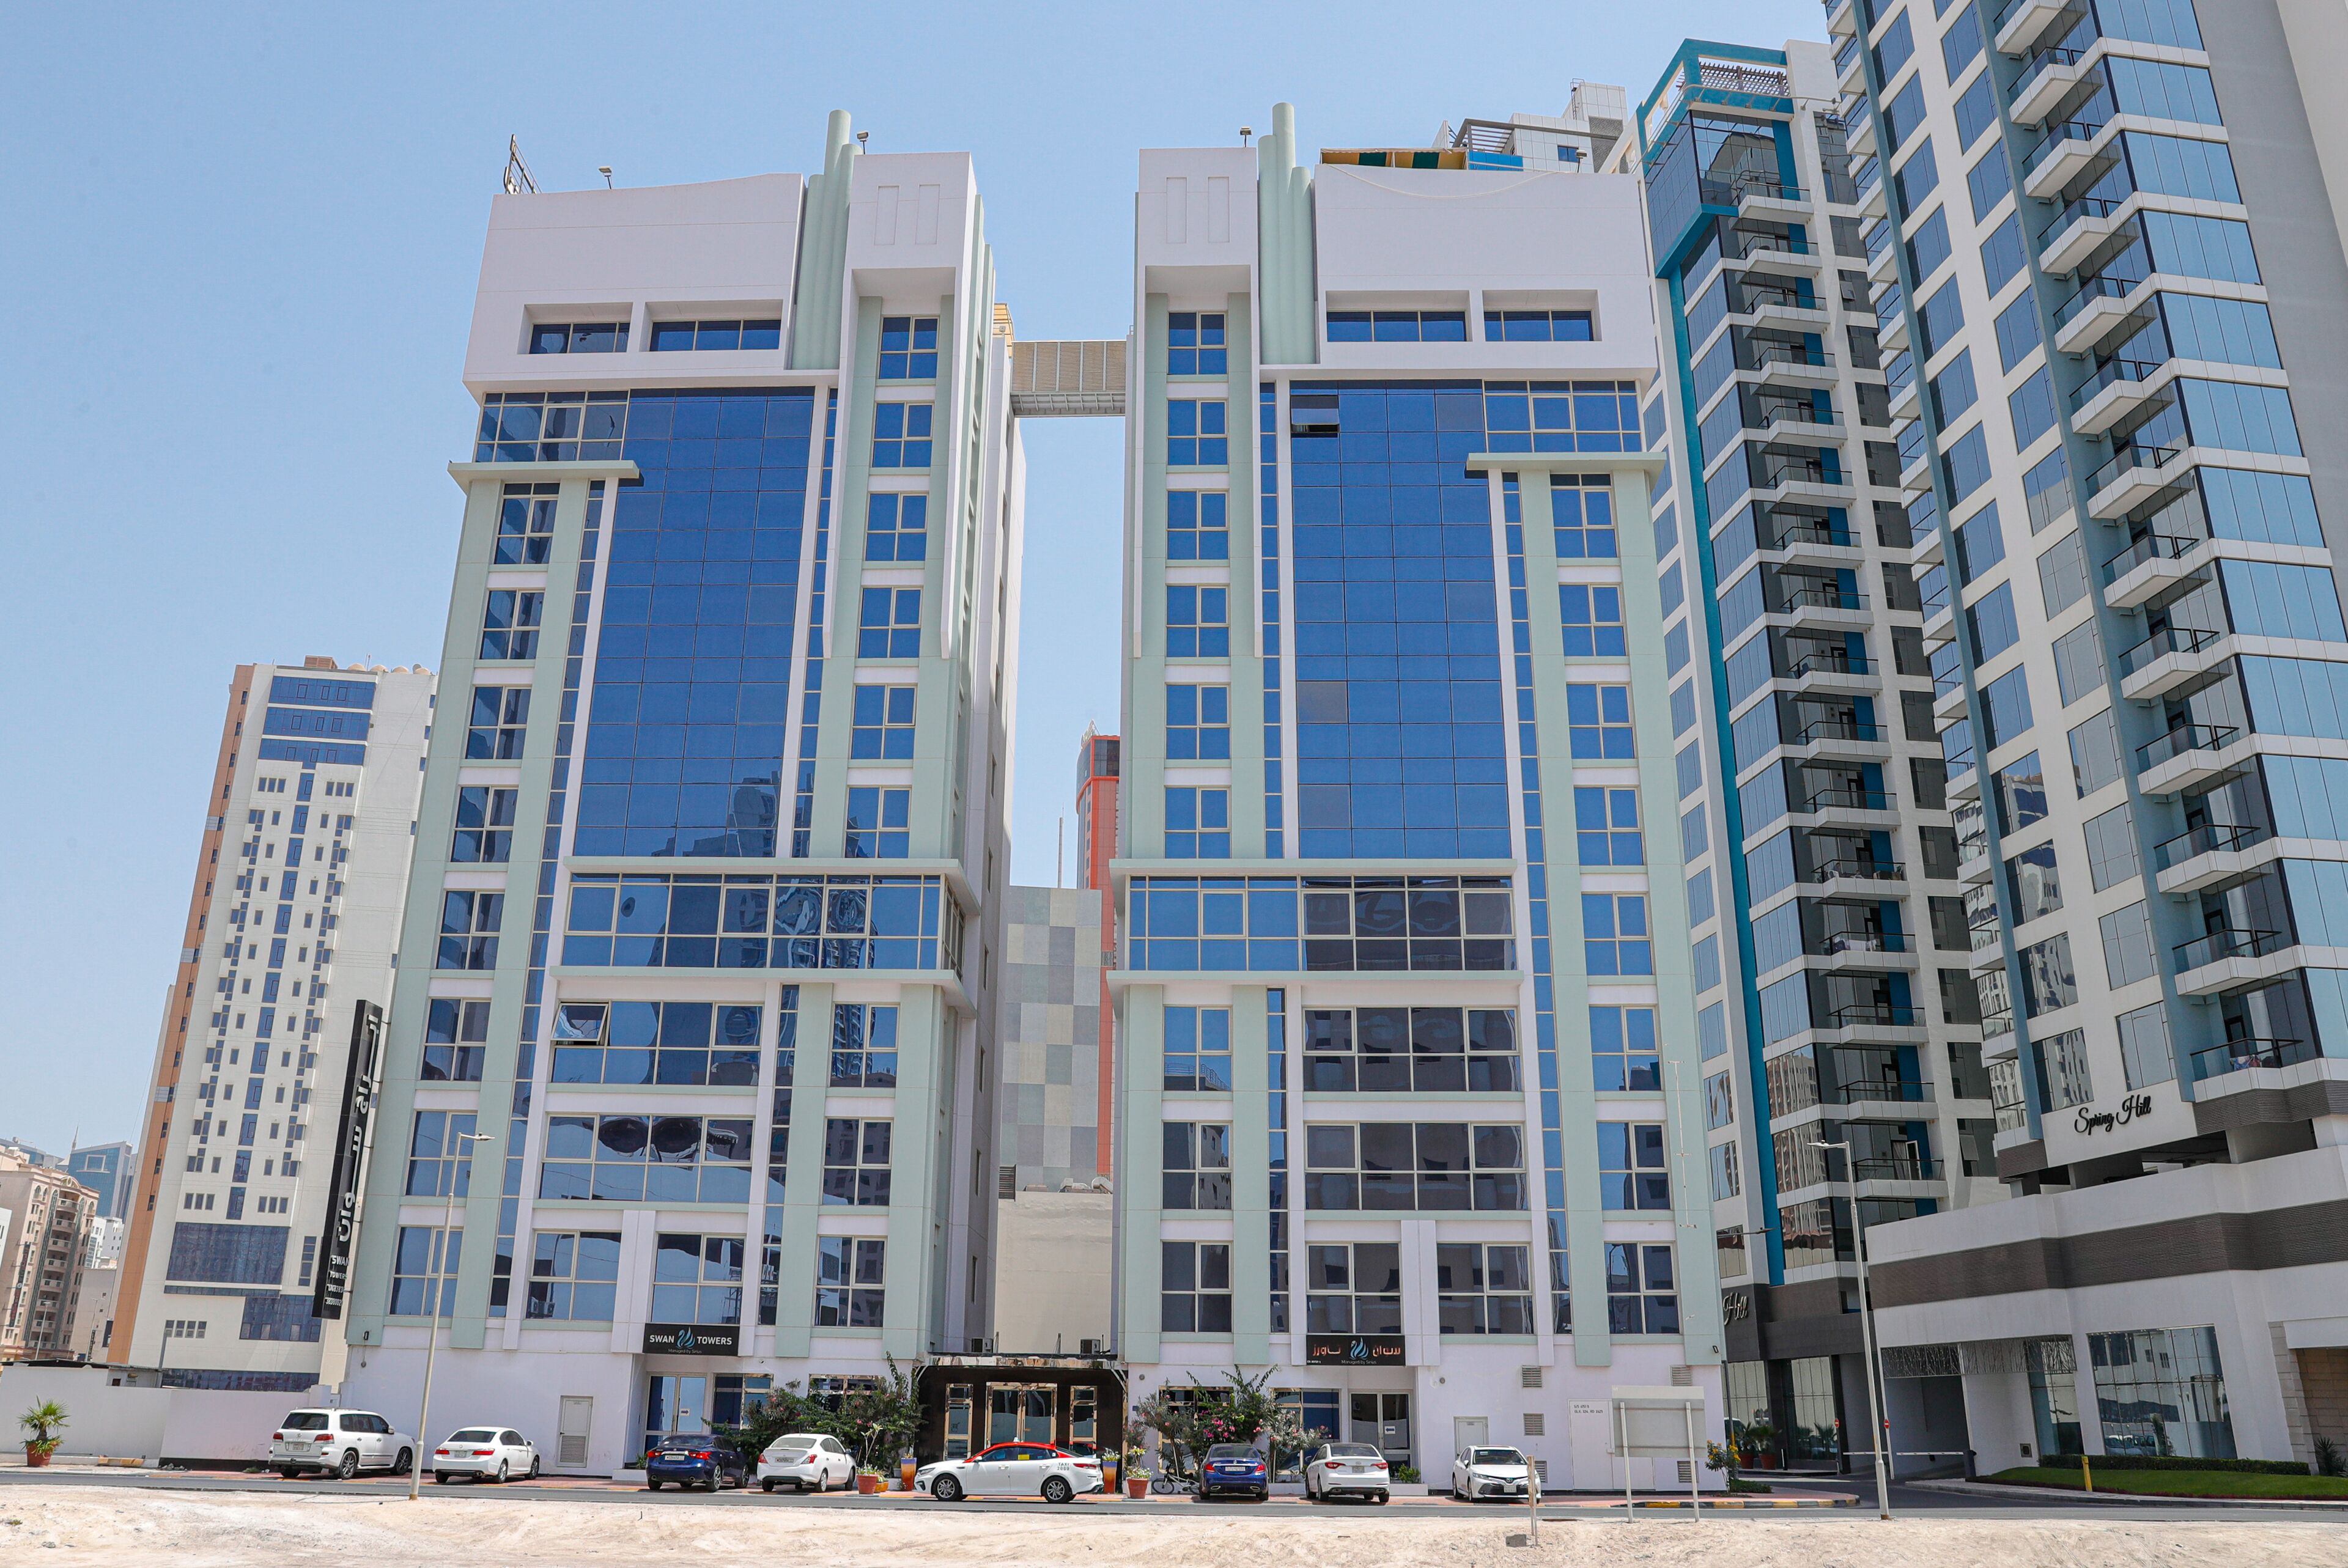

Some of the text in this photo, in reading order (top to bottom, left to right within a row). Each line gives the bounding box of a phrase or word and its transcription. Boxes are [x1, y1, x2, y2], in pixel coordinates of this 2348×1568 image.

[2073, 1094, 2151, 1136] Spring Hill
[330, 1255, 350, 1266] SWAN
[330, 1271, 347, 1280] TOWERS
[1722, 1292, 1748, 1325] Hill
[697, 1336, 733, 1345] TOWERS
